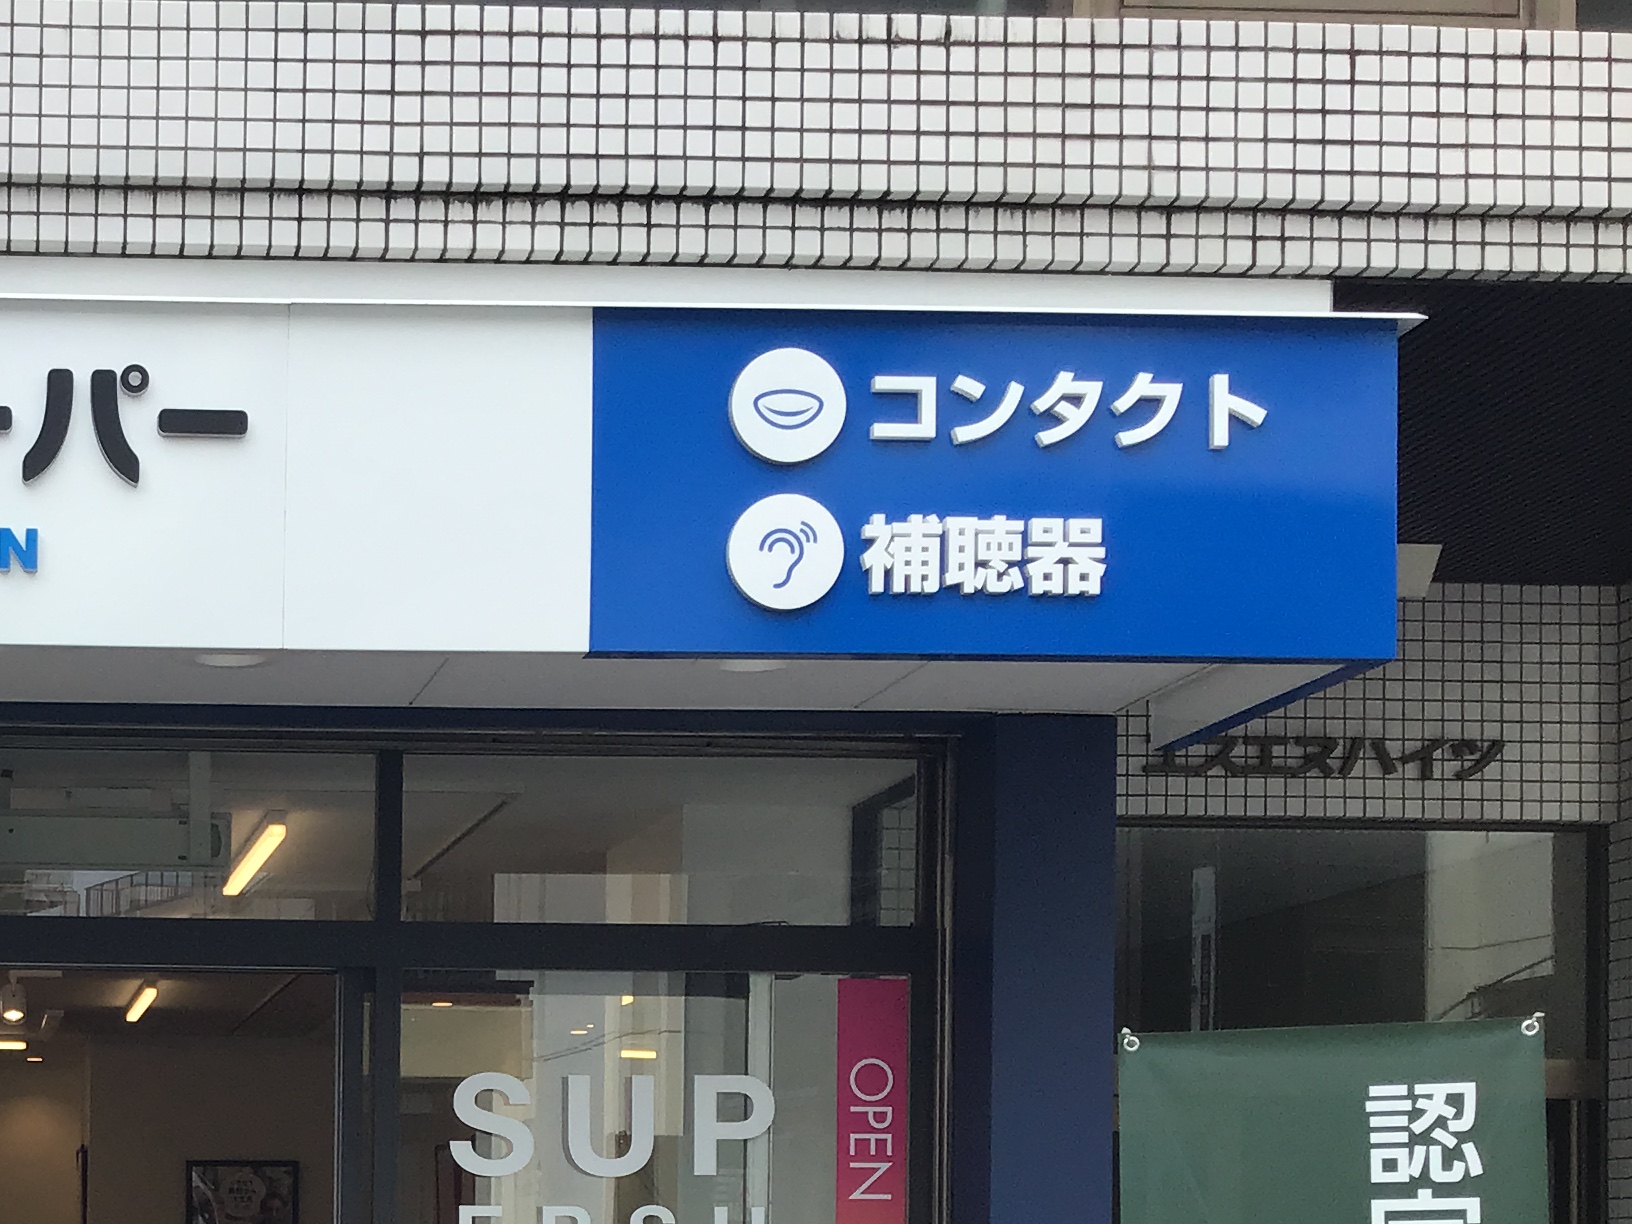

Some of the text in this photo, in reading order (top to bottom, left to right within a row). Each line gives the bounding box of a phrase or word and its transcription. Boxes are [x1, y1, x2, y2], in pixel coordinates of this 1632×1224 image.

[869, 370, 1269, 451] コンタクト
[861, 512, 1109, 598] 補聴器
[449, 1071, 776, 1178] SUP
[848, 1057, 894, 1201] OPEN
